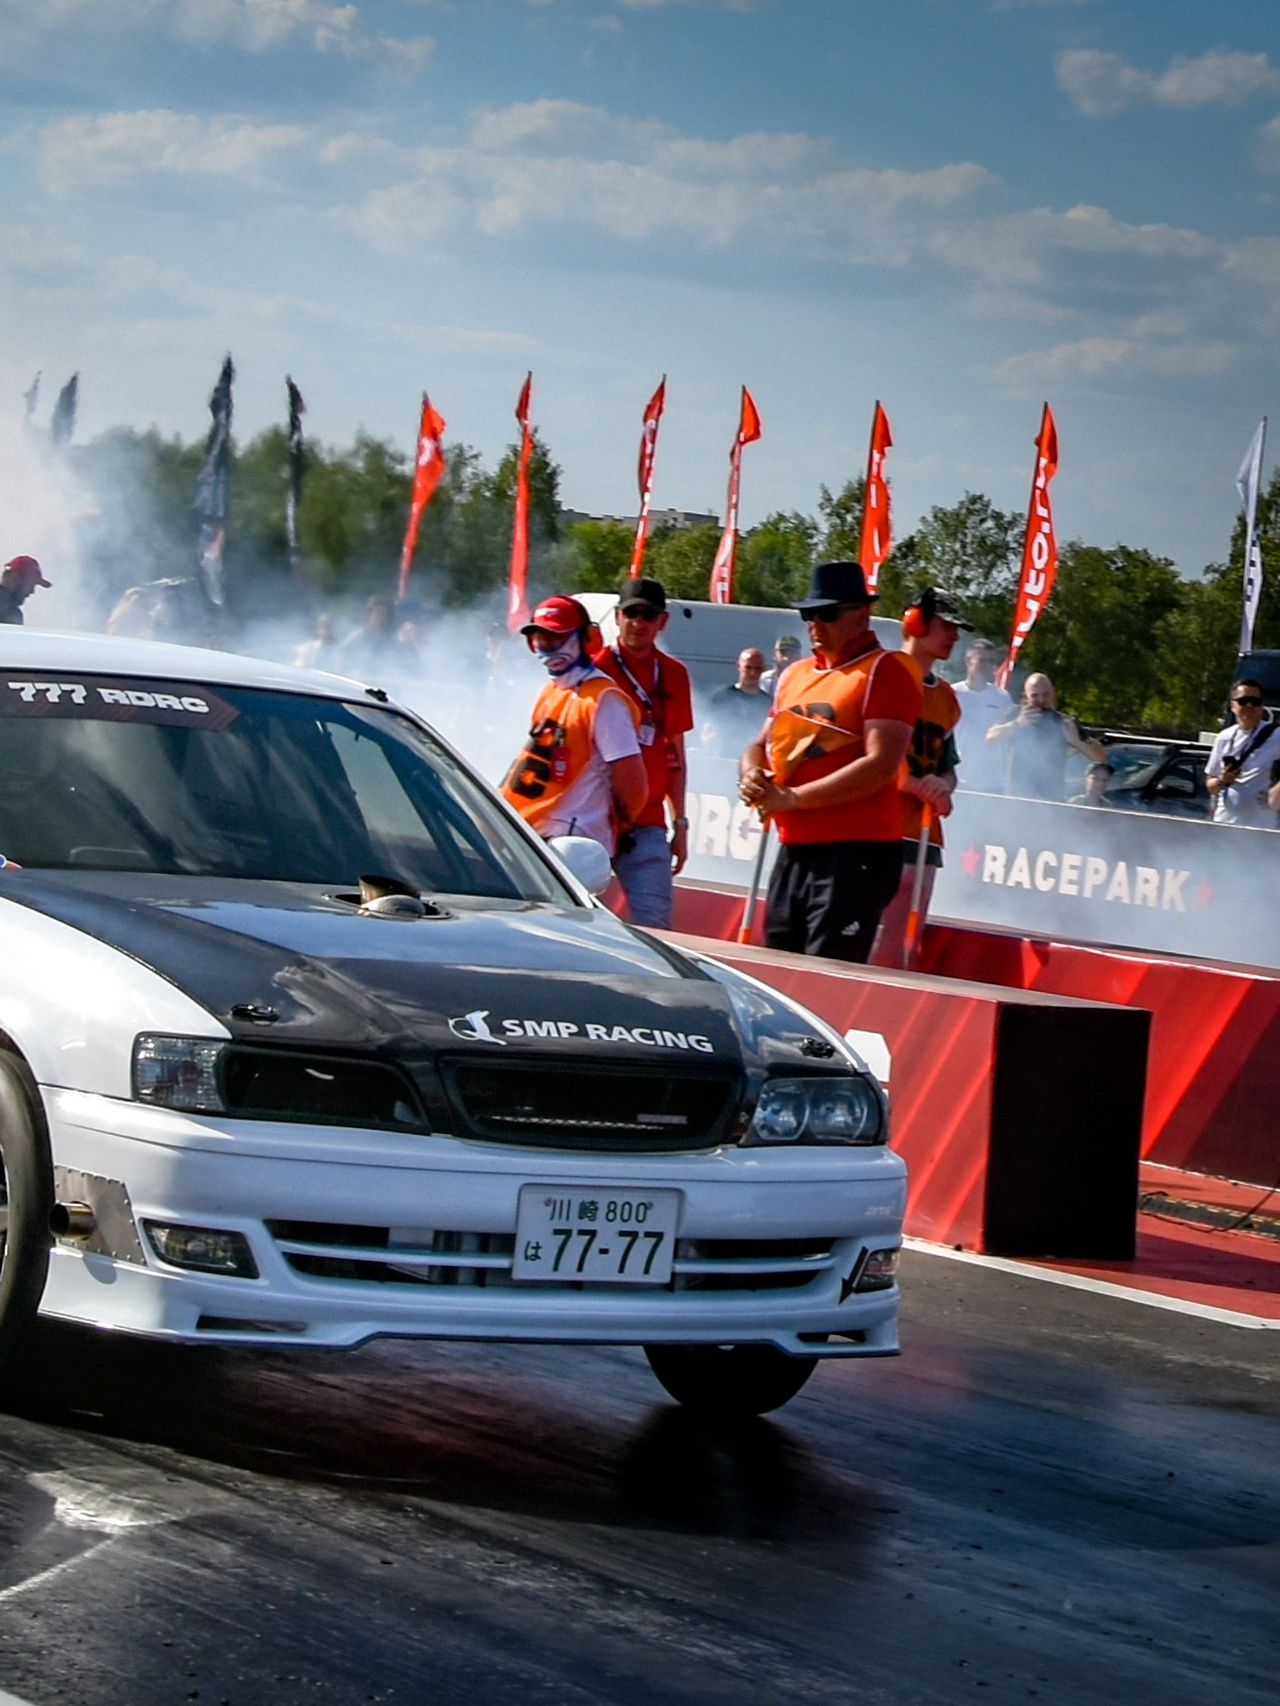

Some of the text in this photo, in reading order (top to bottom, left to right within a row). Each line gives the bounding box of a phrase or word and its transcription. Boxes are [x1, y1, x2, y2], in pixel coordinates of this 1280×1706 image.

[7, 681, 210, 713] 777 RDRC
[982, 844, 1191, 913] RACEPARK
[501, 1019, 714, 1053] SMP RACING
[549, 1199, 648, 1223] 川崎 800
[552, 1228, 665, 1275] 77-77
